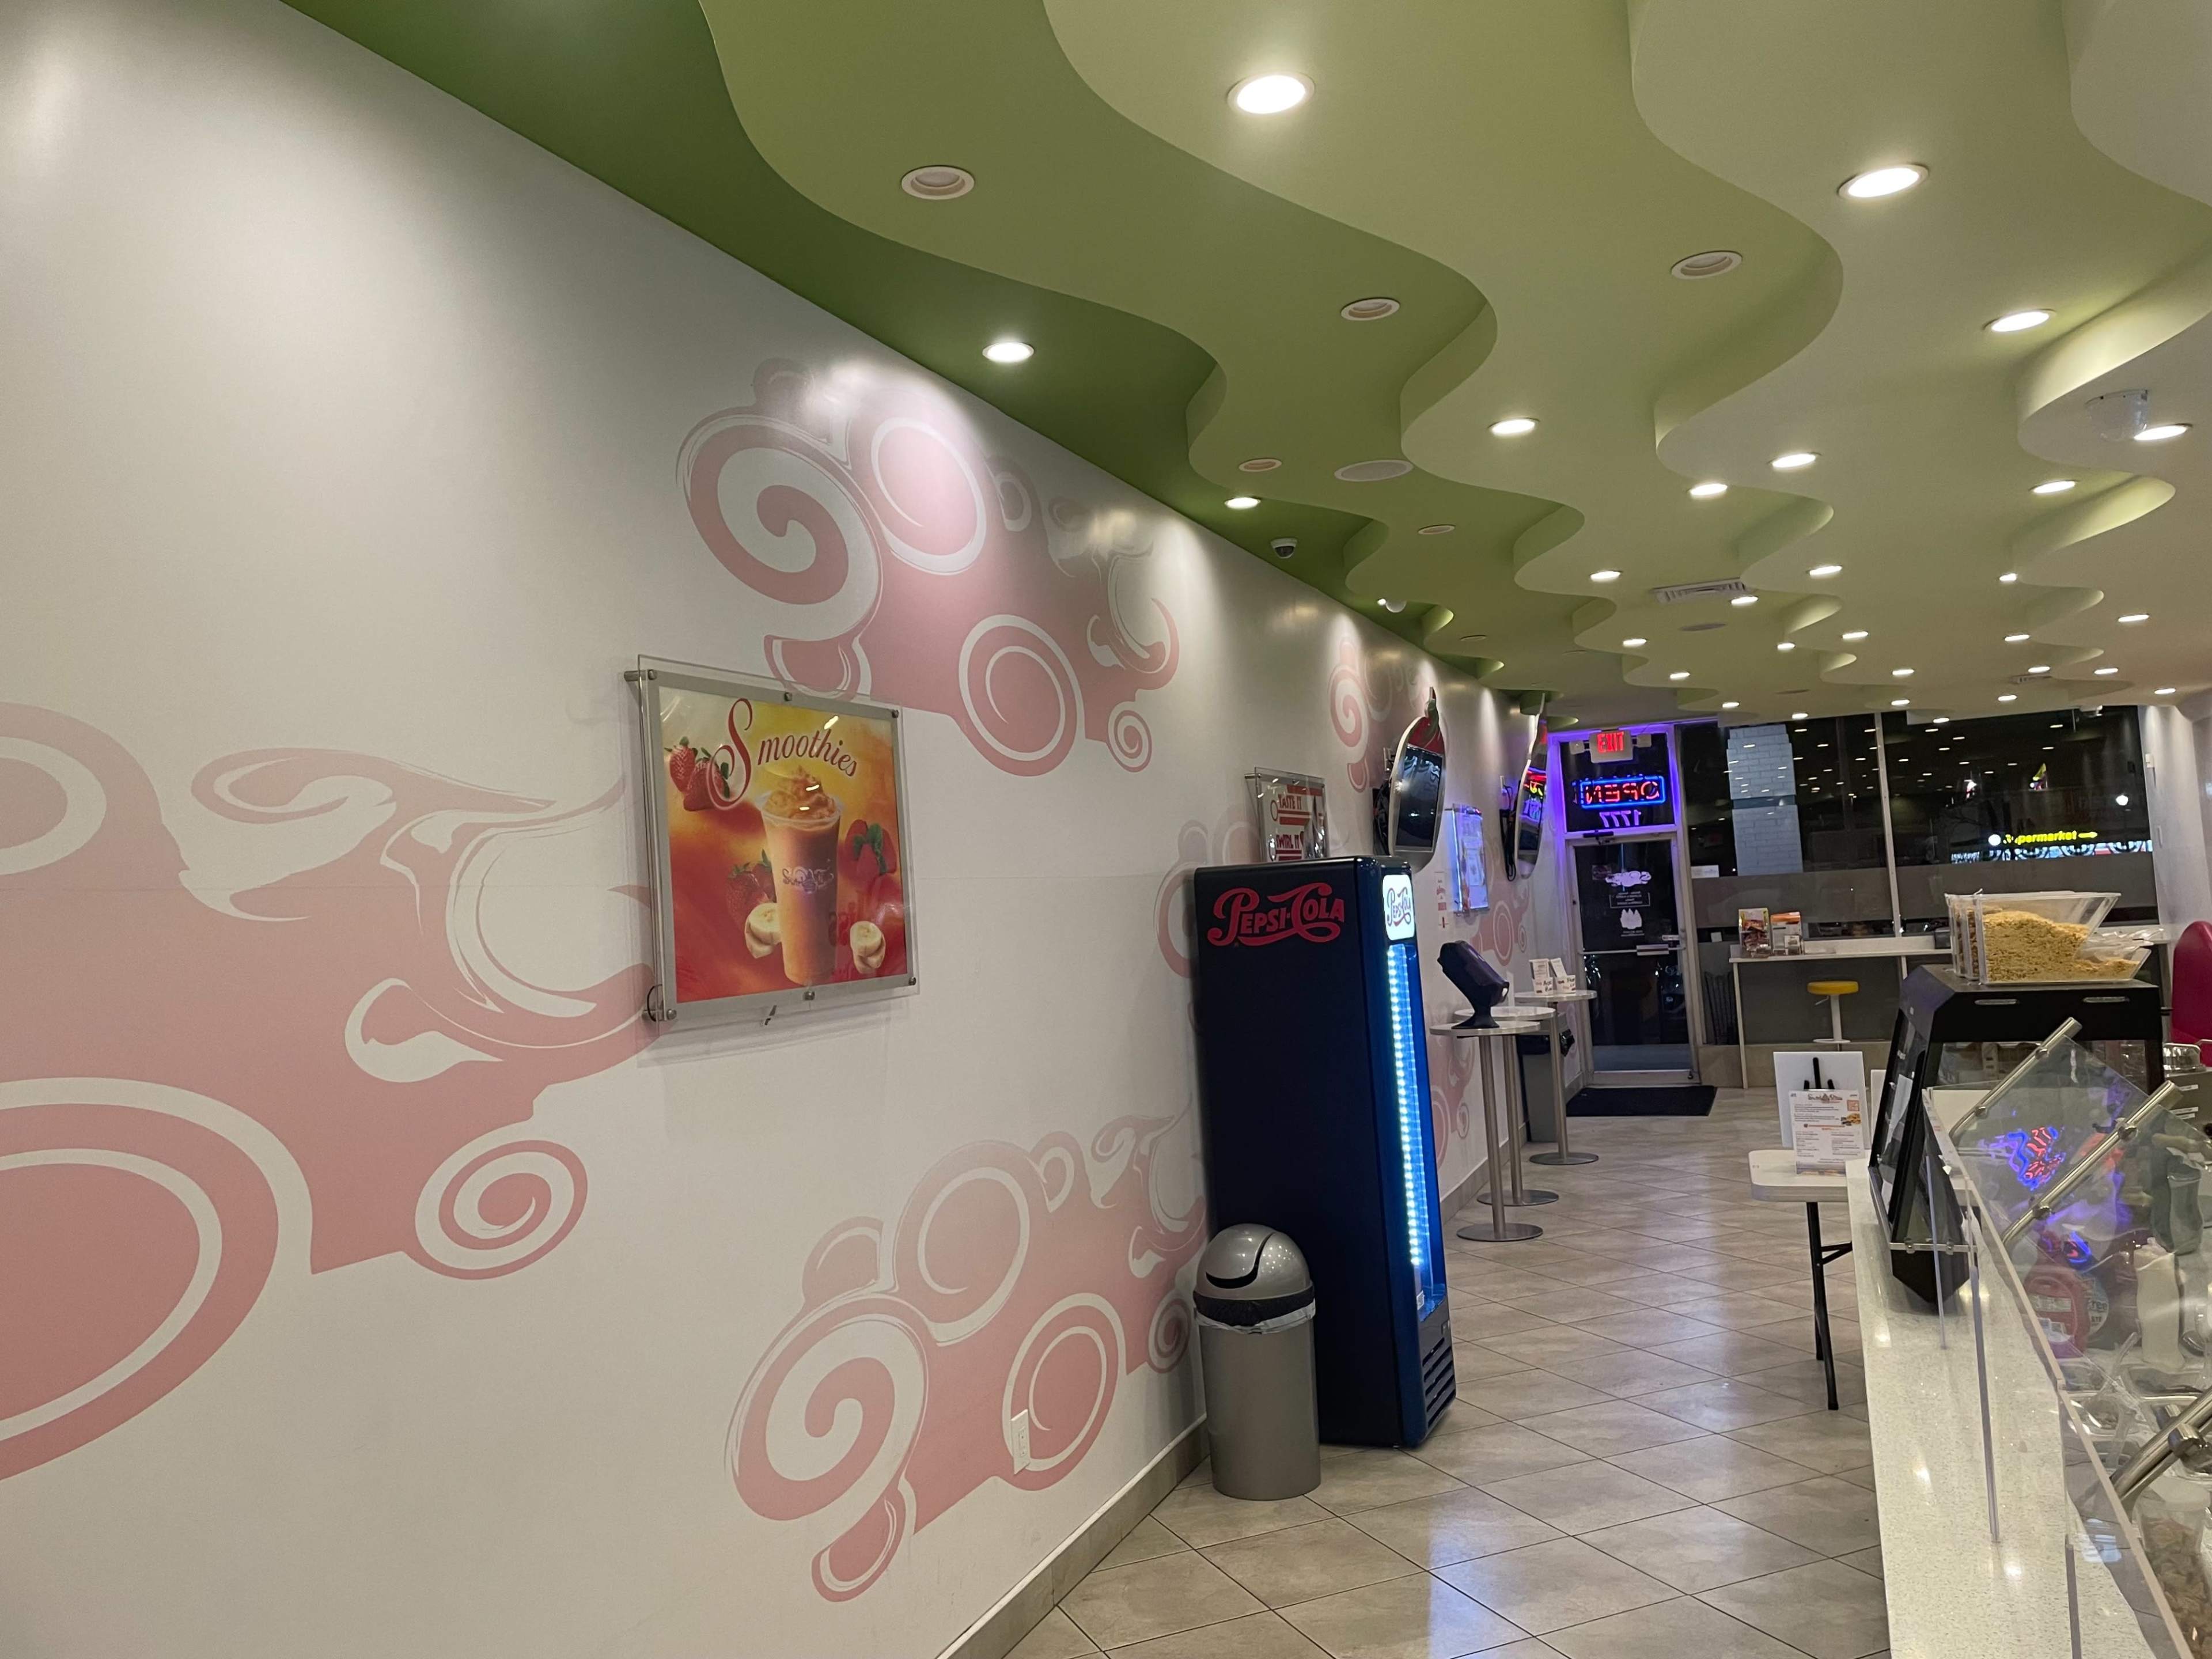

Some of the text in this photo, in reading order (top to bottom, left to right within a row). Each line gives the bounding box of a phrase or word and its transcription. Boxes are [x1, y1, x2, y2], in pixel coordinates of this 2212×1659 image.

[1597, 731, 1624, 753] EXIT
[707, 698, 858, 806] Smoothies
[1278, 794, 1296, 809] TASTE
[1276, 834, 1294, 849] SWIRL
